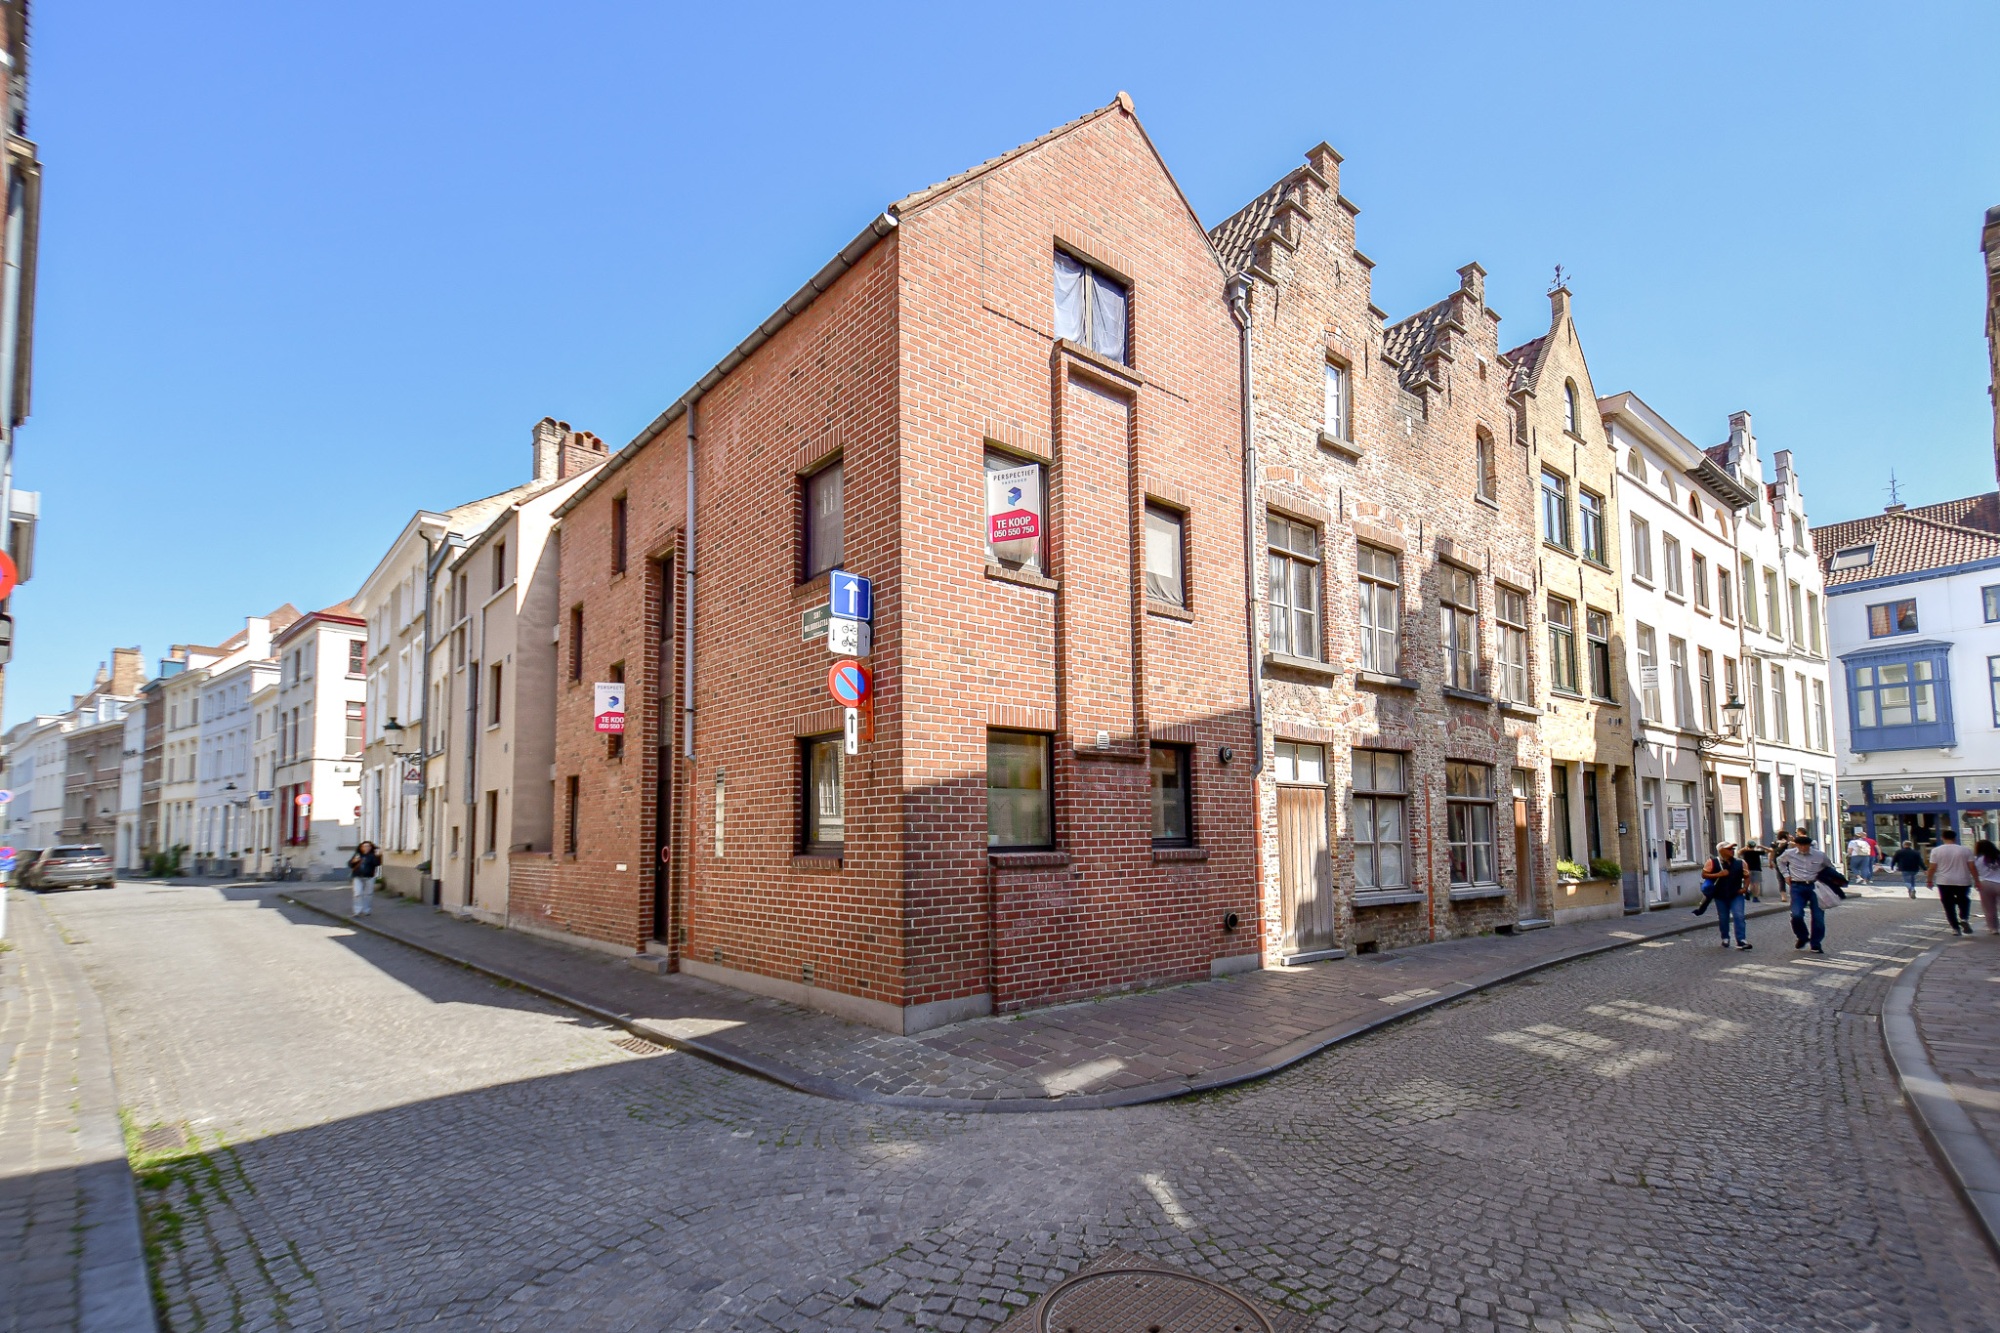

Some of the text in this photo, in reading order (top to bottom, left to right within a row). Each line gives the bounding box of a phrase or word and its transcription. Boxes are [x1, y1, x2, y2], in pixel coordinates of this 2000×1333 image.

[993, 469, 1035, 481] PERSPECTIEF
[996, 516, 1031, 529] TE KOOP
[994, 525, 1035, 538] 050 550 750
[1885, 792, 1932, 800] KINGPIN
